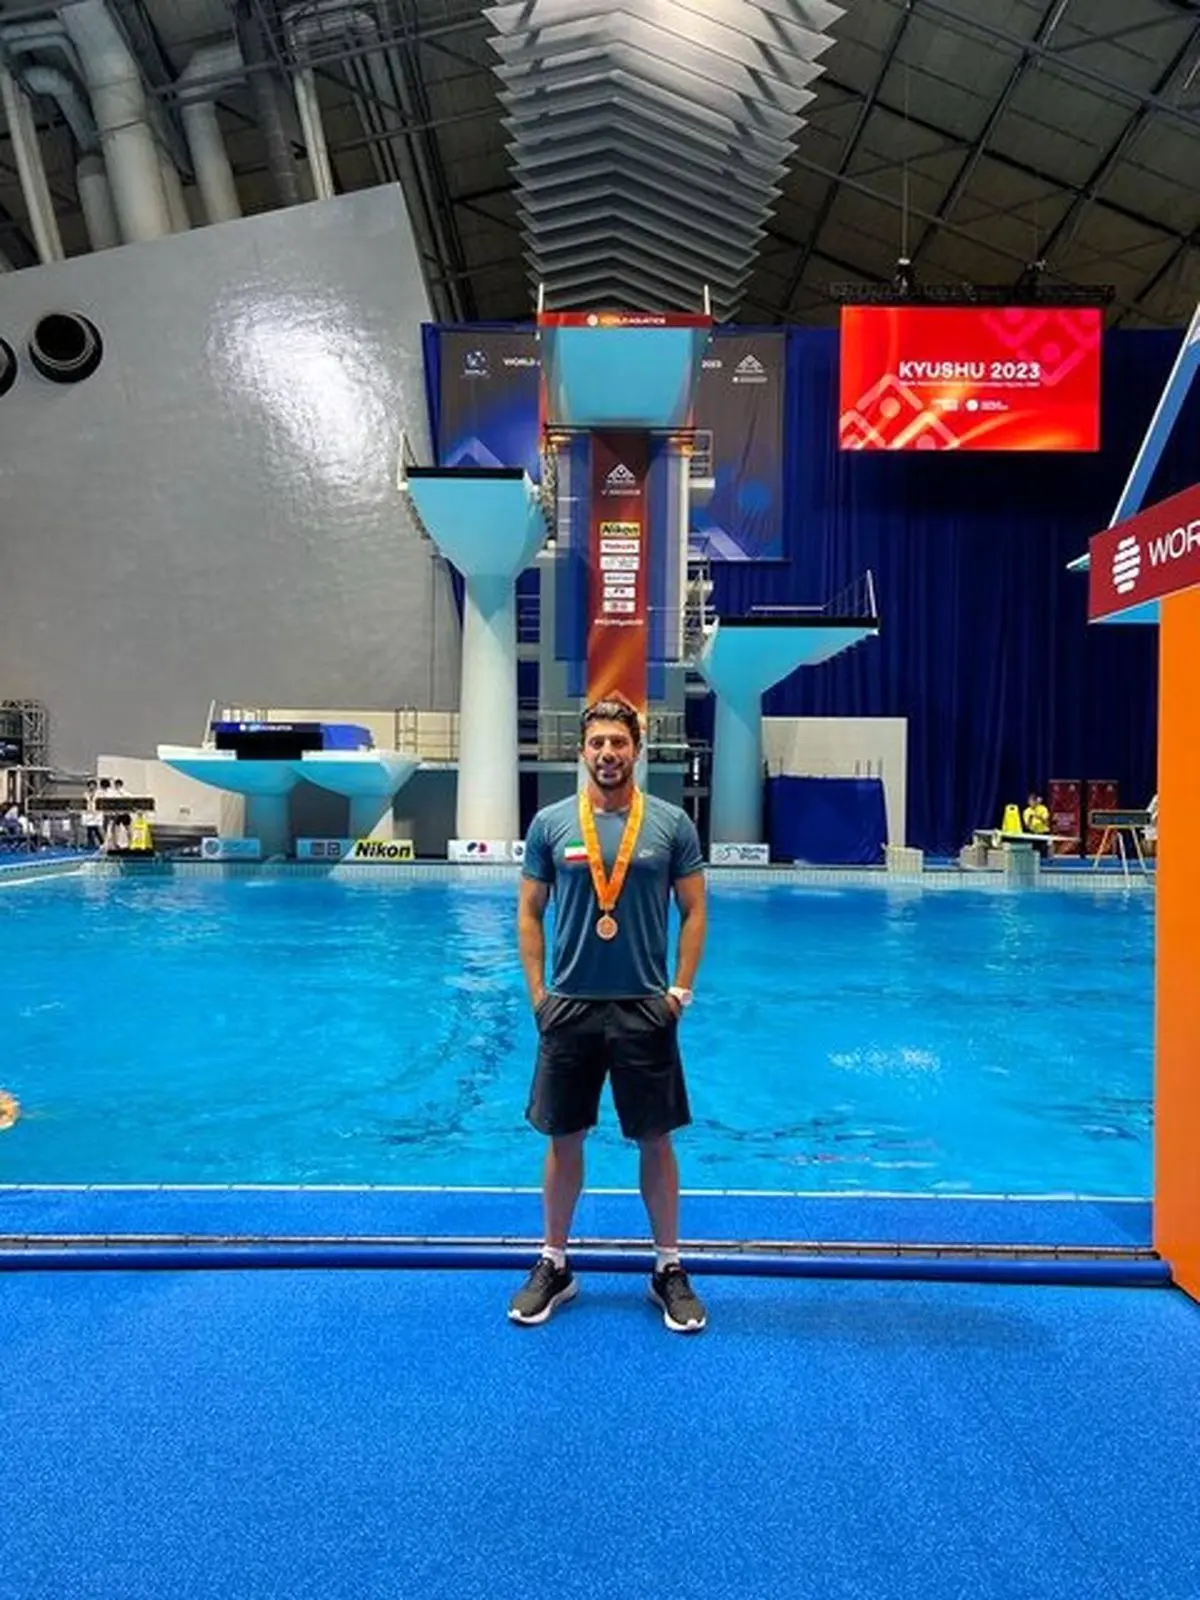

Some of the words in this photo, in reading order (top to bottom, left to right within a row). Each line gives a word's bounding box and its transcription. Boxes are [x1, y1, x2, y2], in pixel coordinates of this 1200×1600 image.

[898, 360, 985, 379] KYUSHU
[990, 361, 1040, 380] 2023
[355, 841, 410, 858] Nikon
